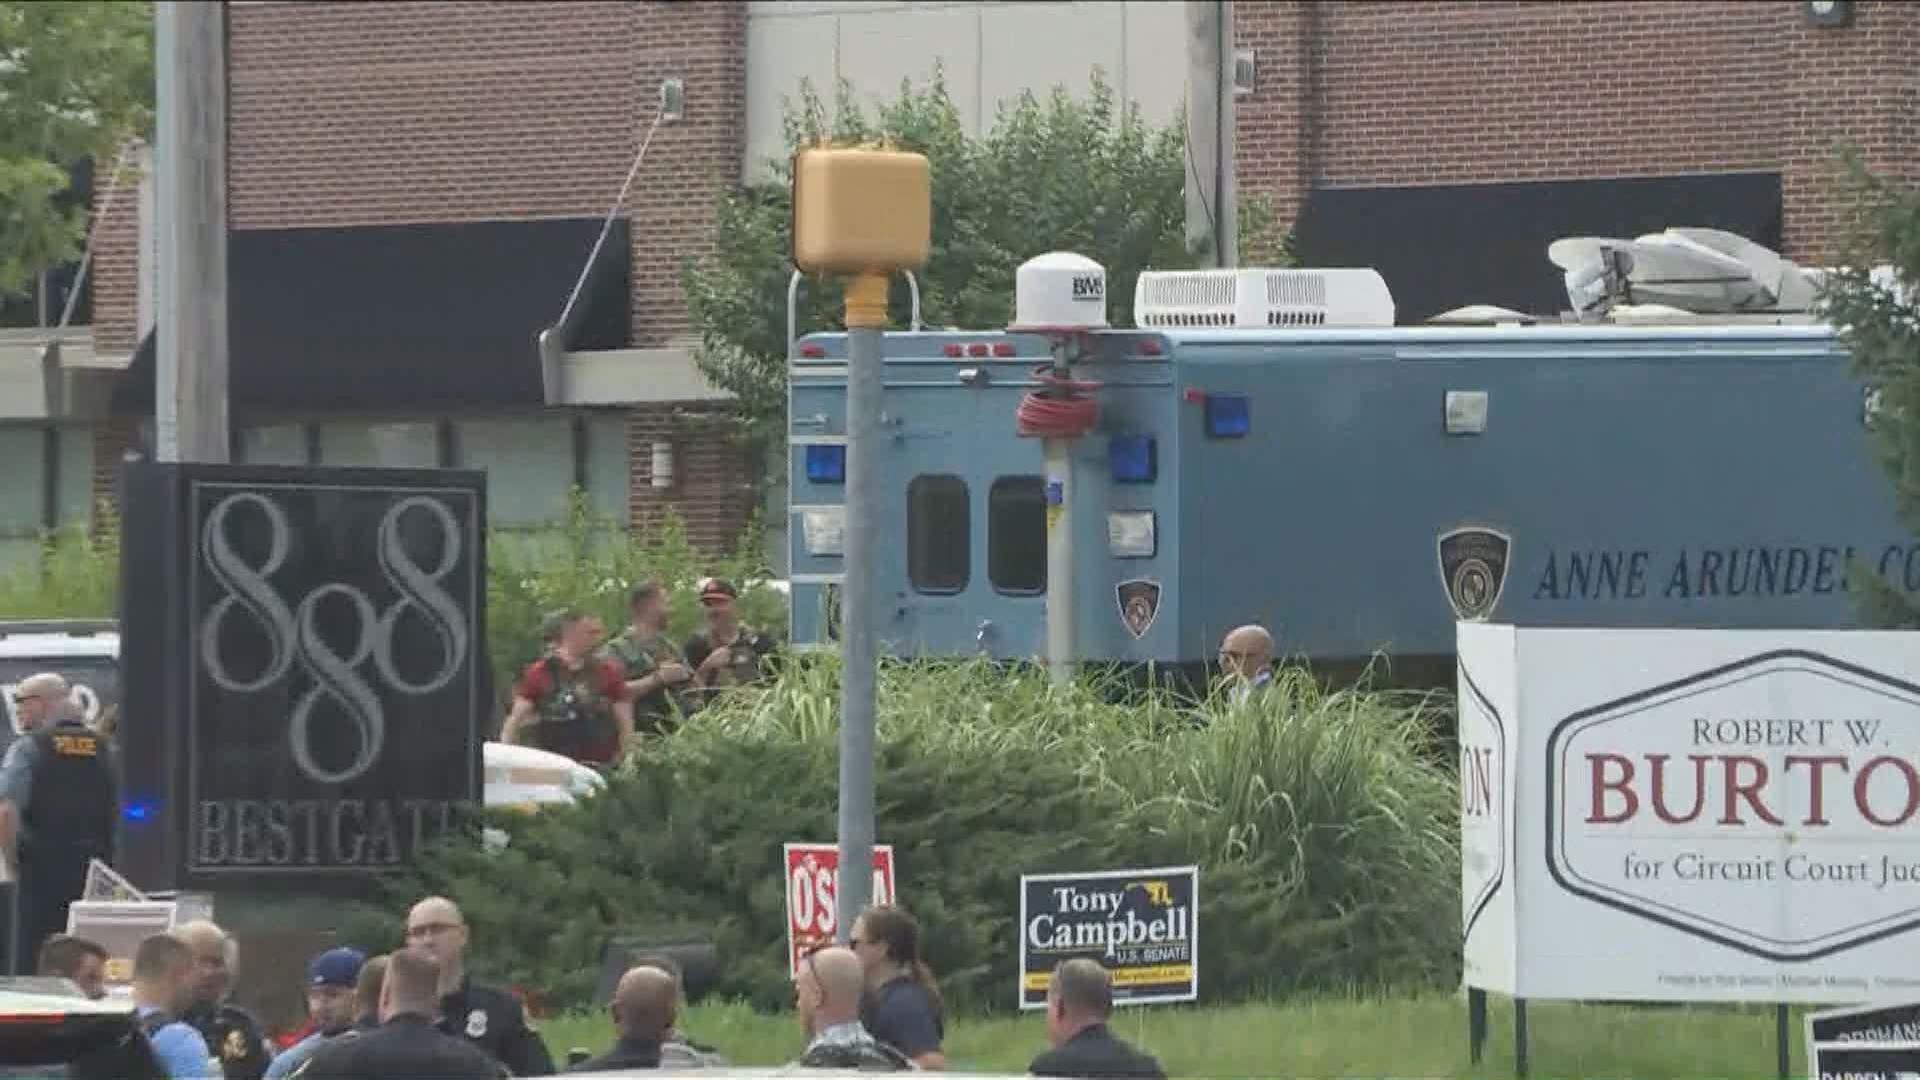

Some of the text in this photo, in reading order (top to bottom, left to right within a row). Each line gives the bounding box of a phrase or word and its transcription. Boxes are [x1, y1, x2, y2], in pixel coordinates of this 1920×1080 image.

[1534, 551, 1649, 600] ANNE
[1693, 718, 1889, 746] ROBERT W.
[1584, 753, 1920, 826] BURTO
[1625, 853, 1663, 880] for
[1673, 853, 1776, 881] Circuit
[1784, 854, 1872, 881] Court
[1053, 886, 1125, 919] Tony
[1028, 907, 1188, 958] Campbell
